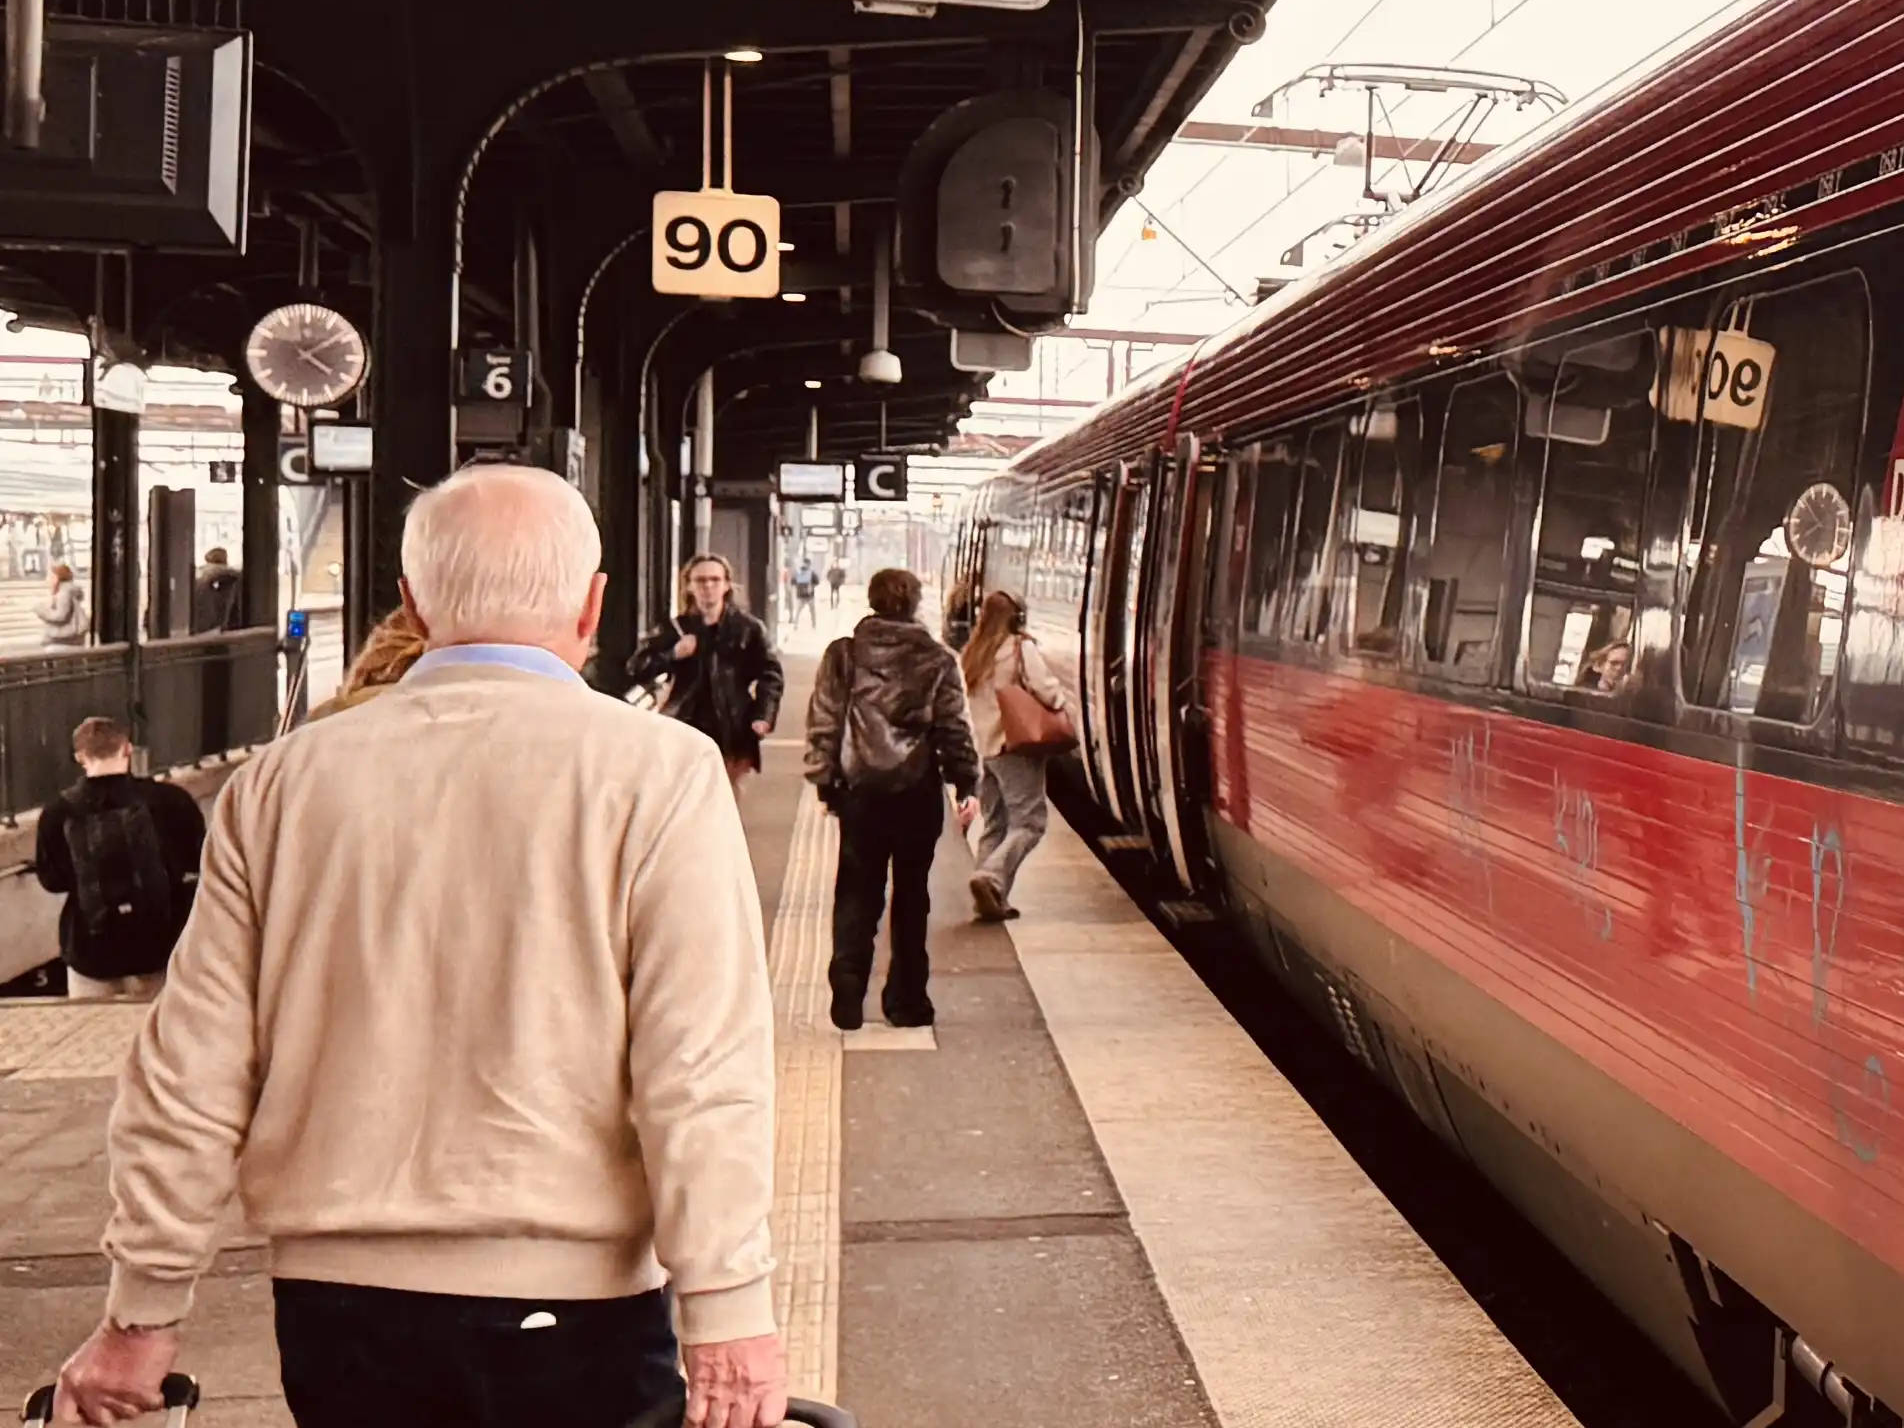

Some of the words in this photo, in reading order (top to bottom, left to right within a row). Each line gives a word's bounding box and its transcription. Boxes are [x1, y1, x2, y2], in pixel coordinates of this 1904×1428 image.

[664, 215, 768, 273] 90
[485, 366, 513, 400] 6
[280, 447, 309, 482] C
[868, 465, 896, 498] C
